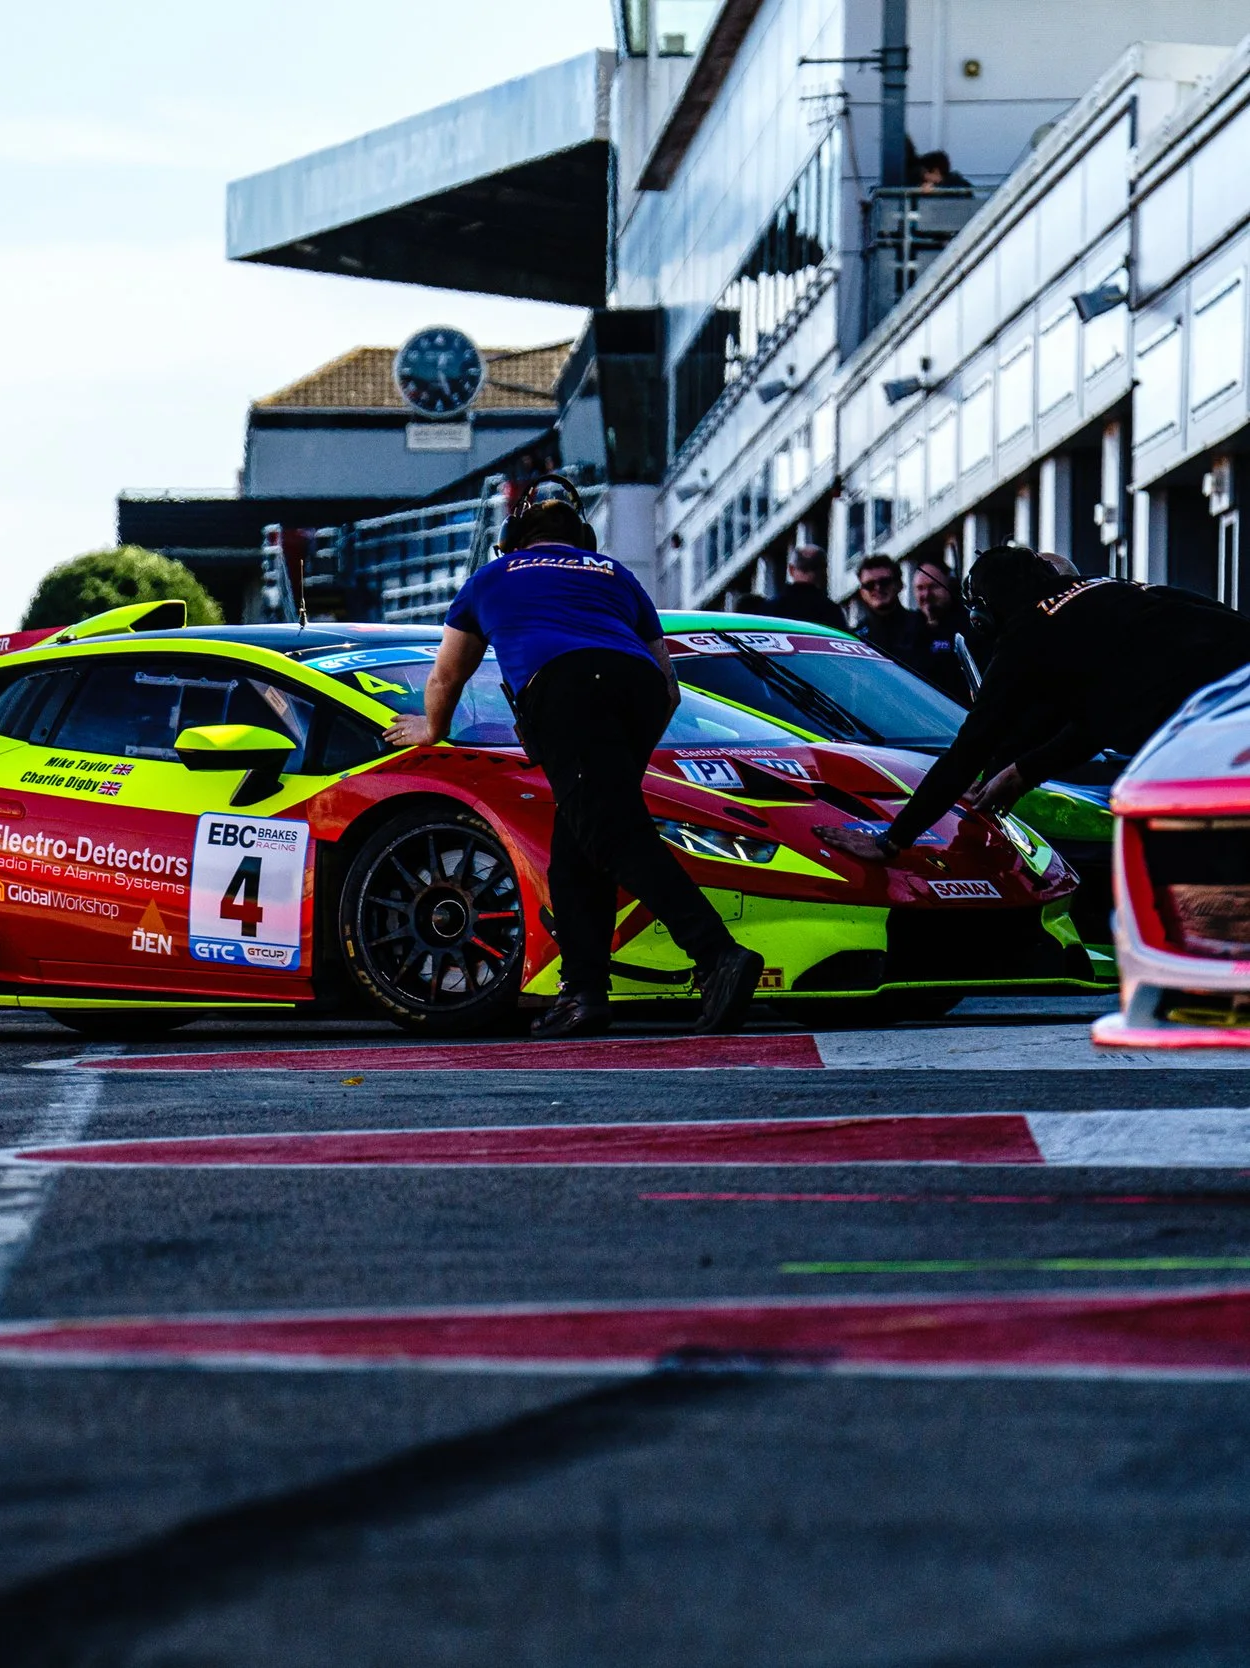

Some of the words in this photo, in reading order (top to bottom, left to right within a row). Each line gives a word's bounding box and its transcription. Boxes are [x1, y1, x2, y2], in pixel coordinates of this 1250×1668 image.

[317, 655, 378, 669] GTC
[353, 671, 409, 695] 4
[674, 748, 778, 758] Electro-Detectors
[45, 757, 75, 769] Mike
[75, 760, 113, 772] Taylor
[678, 760, 734, 782] TPT
[20, 771, 65, 787] Charlie
[64, 776, 101, 793] Digby
[208, 822, 257, 849] EBC
[258, 828, 298, 841] BRAKES
[256, 842, 296, 852] RACING
[31, 860, 61, 876] Fire
[64, 865, 111, 883] Alarm
[114, 872, 185, 895] Systems
[220, 856, 263, 937] 4
[934, 883, 997, 896] SONAX
[195, 943, 235, 961] GTC
